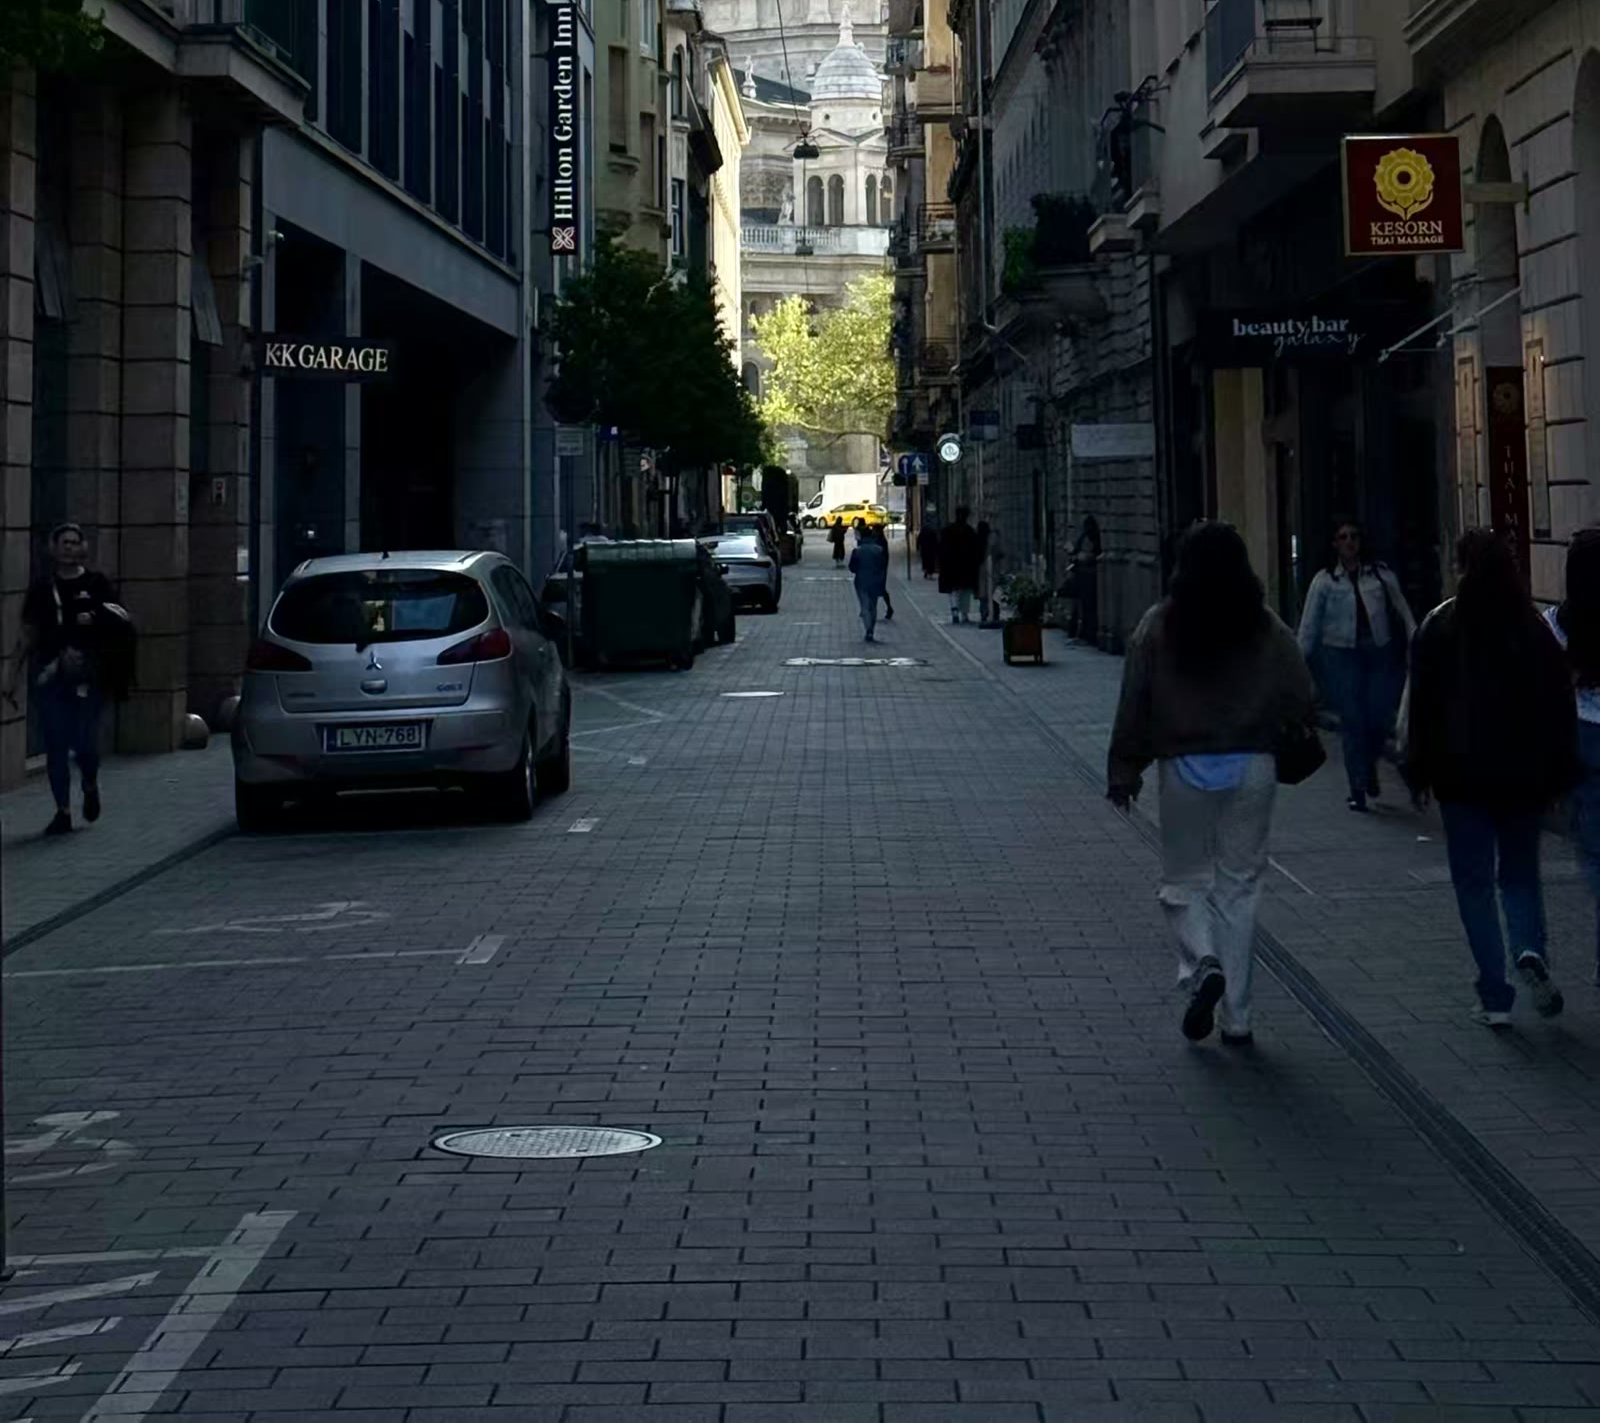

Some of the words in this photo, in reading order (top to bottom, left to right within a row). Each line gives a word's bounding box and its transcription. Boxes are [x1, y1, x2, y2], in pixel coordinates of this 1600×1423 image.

[553, 7, 572, 47] Inn
[553, 56, 573, 142] Garden
[553, 147, 573, 220] Hilton
[1370, 220, 1443, 236] KESORN
[1371, 236, 1395, 246] THAI
[1397, 235, 1445, 245] MASSAGE
[298, 344, 389, 372] GARAGE
